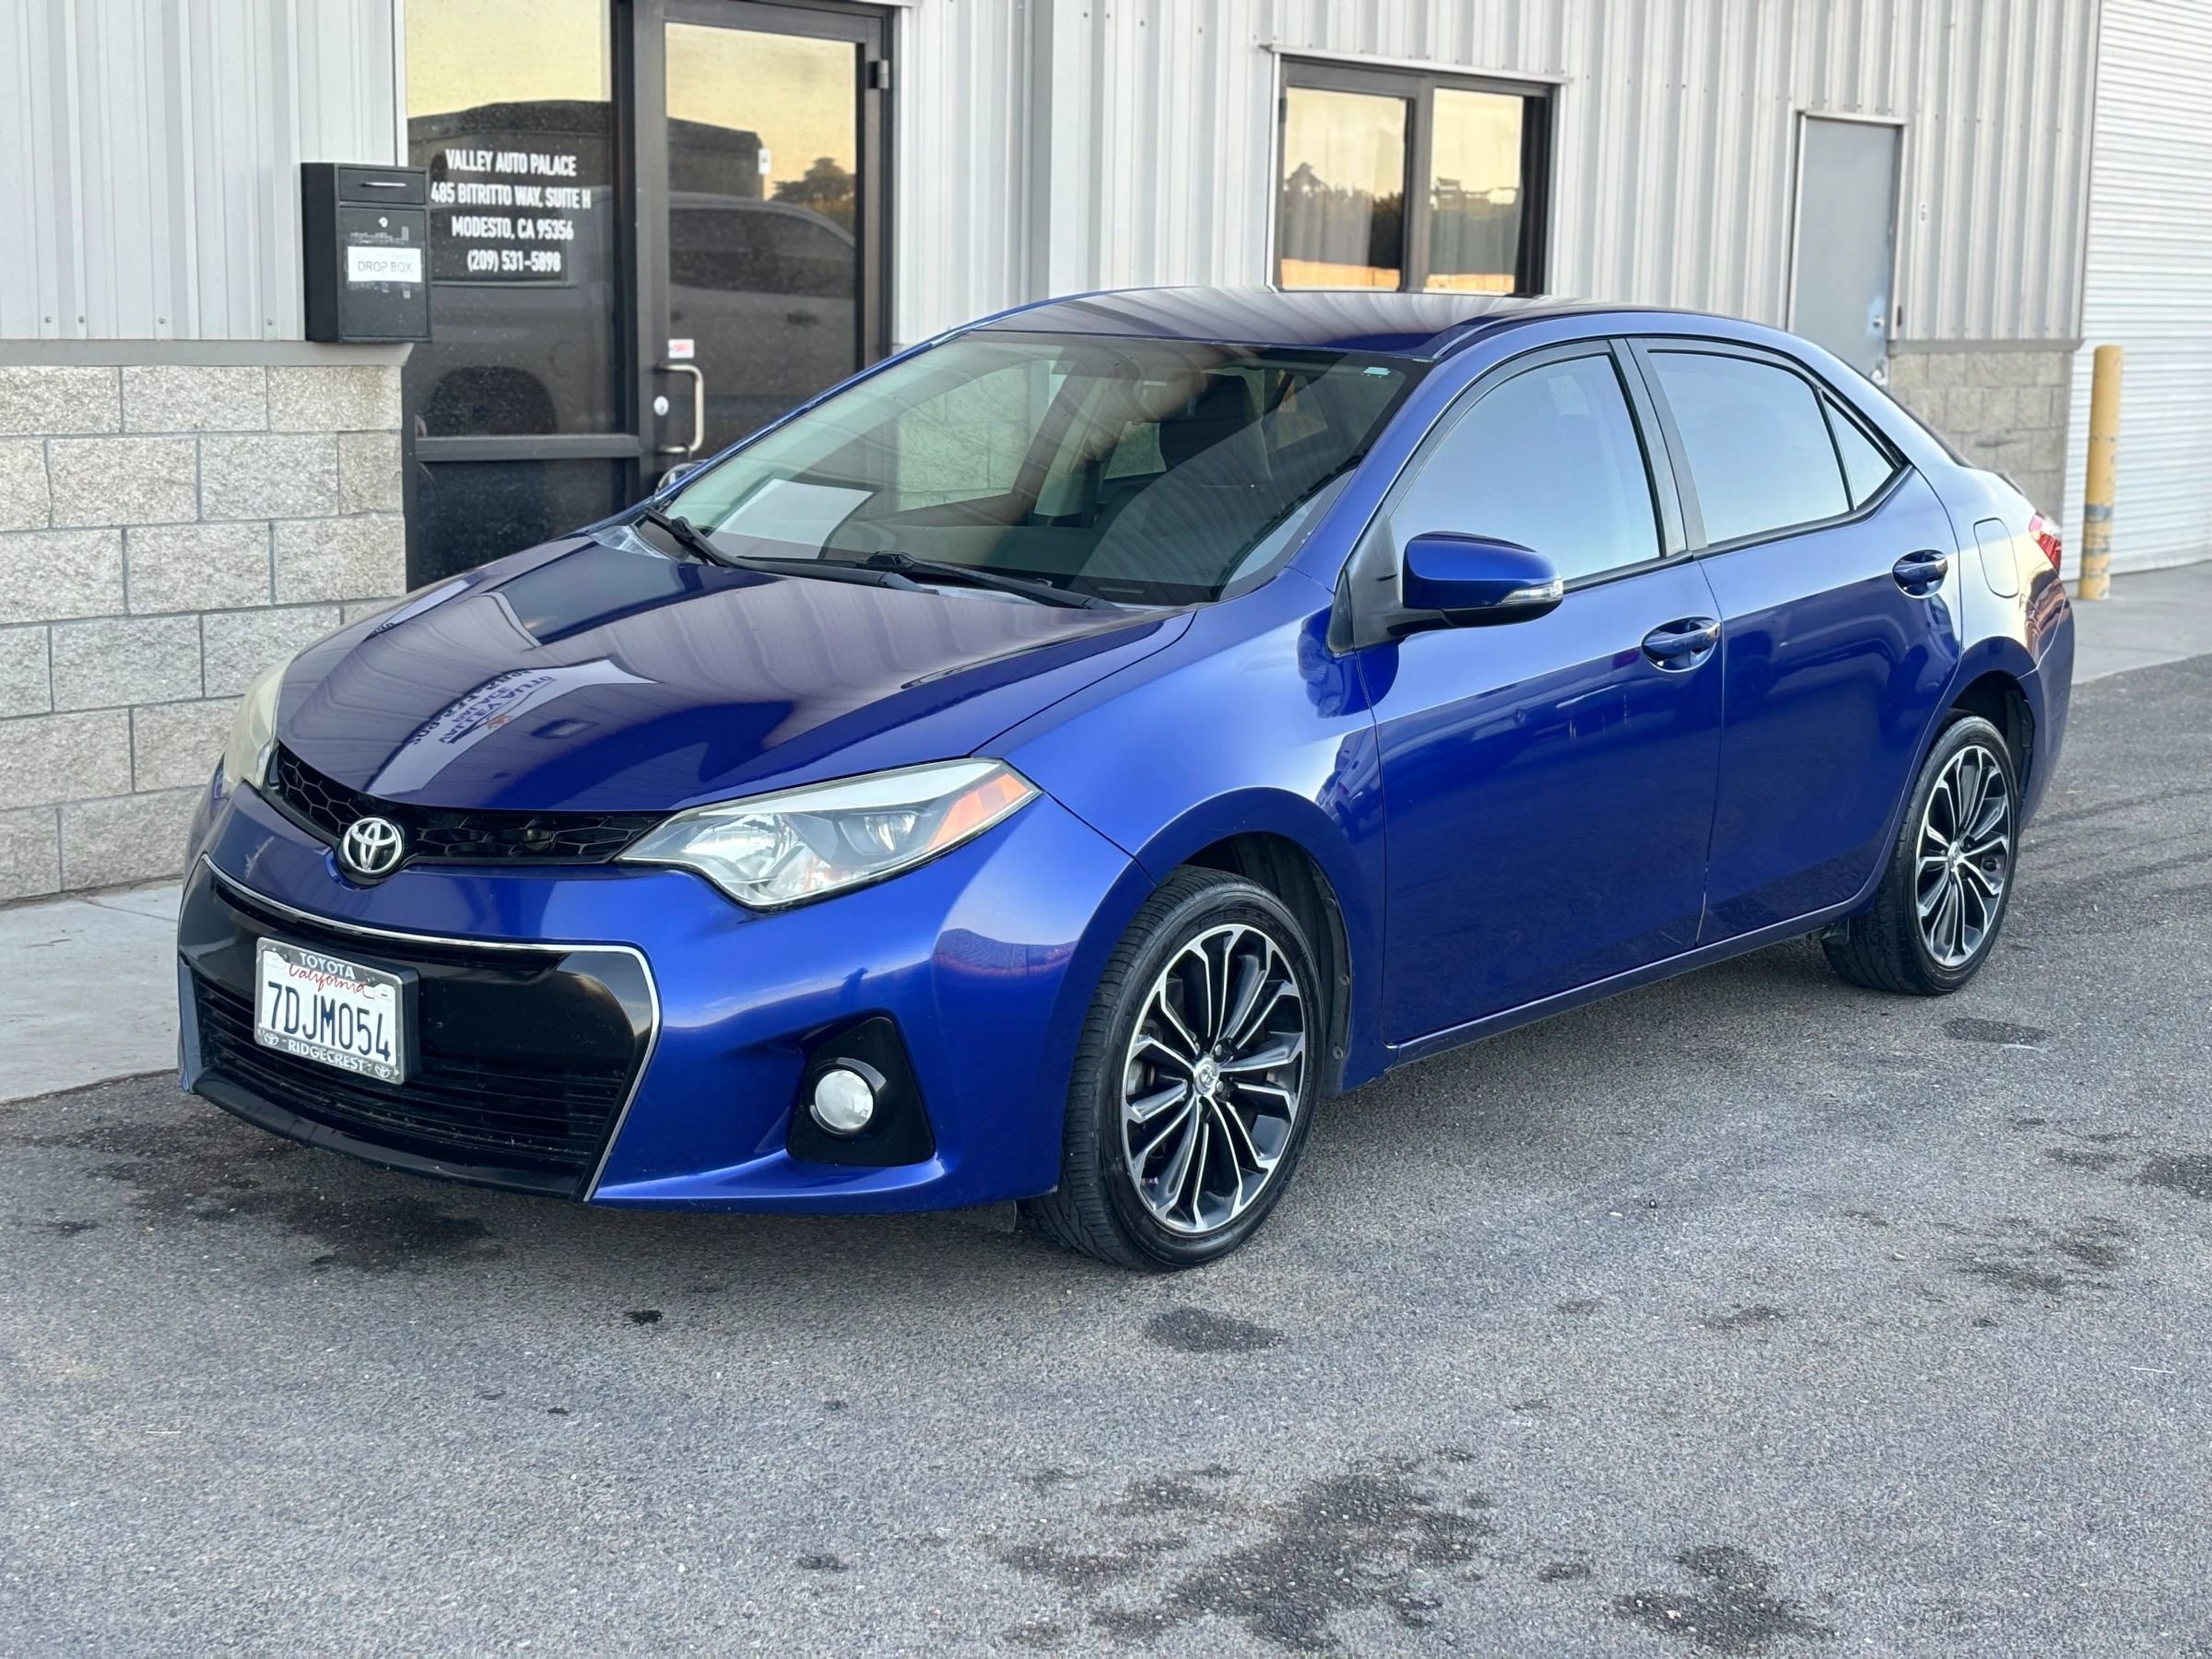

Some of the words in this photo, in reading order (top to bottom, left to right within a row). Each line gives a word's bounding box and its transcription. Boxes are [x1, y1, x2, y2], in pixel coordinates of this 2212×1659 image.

[445, 149, 493, 171] VALLEY
[496, 152, 528, 173] AUTO
[530, 154, 577, 177] PALACE
[430, 182, 454, 204] 485
[457, 182, 512, 206] BITRITTO
[546, 187, 580, 208] SUITE
[582, 189, 592, 208] H
[451, 216, 515, 240] MODESTO,
[517, 218, 535, 240] CA
[536, 219, 574, 241] 95356
[358, 261, 388, 273] DROP
[390, 261, 414, 274] BOX
[467, 250, 499, 272] (209)
[501, 251, 561, 272] 531-5898
[300, 952, 356, 981] TOYOTA
[289, 963, 375, 1000] California
[268, 981, 391, 1062] 7DJM054
[288, 1039, 364, 1072] RIDGECREST
